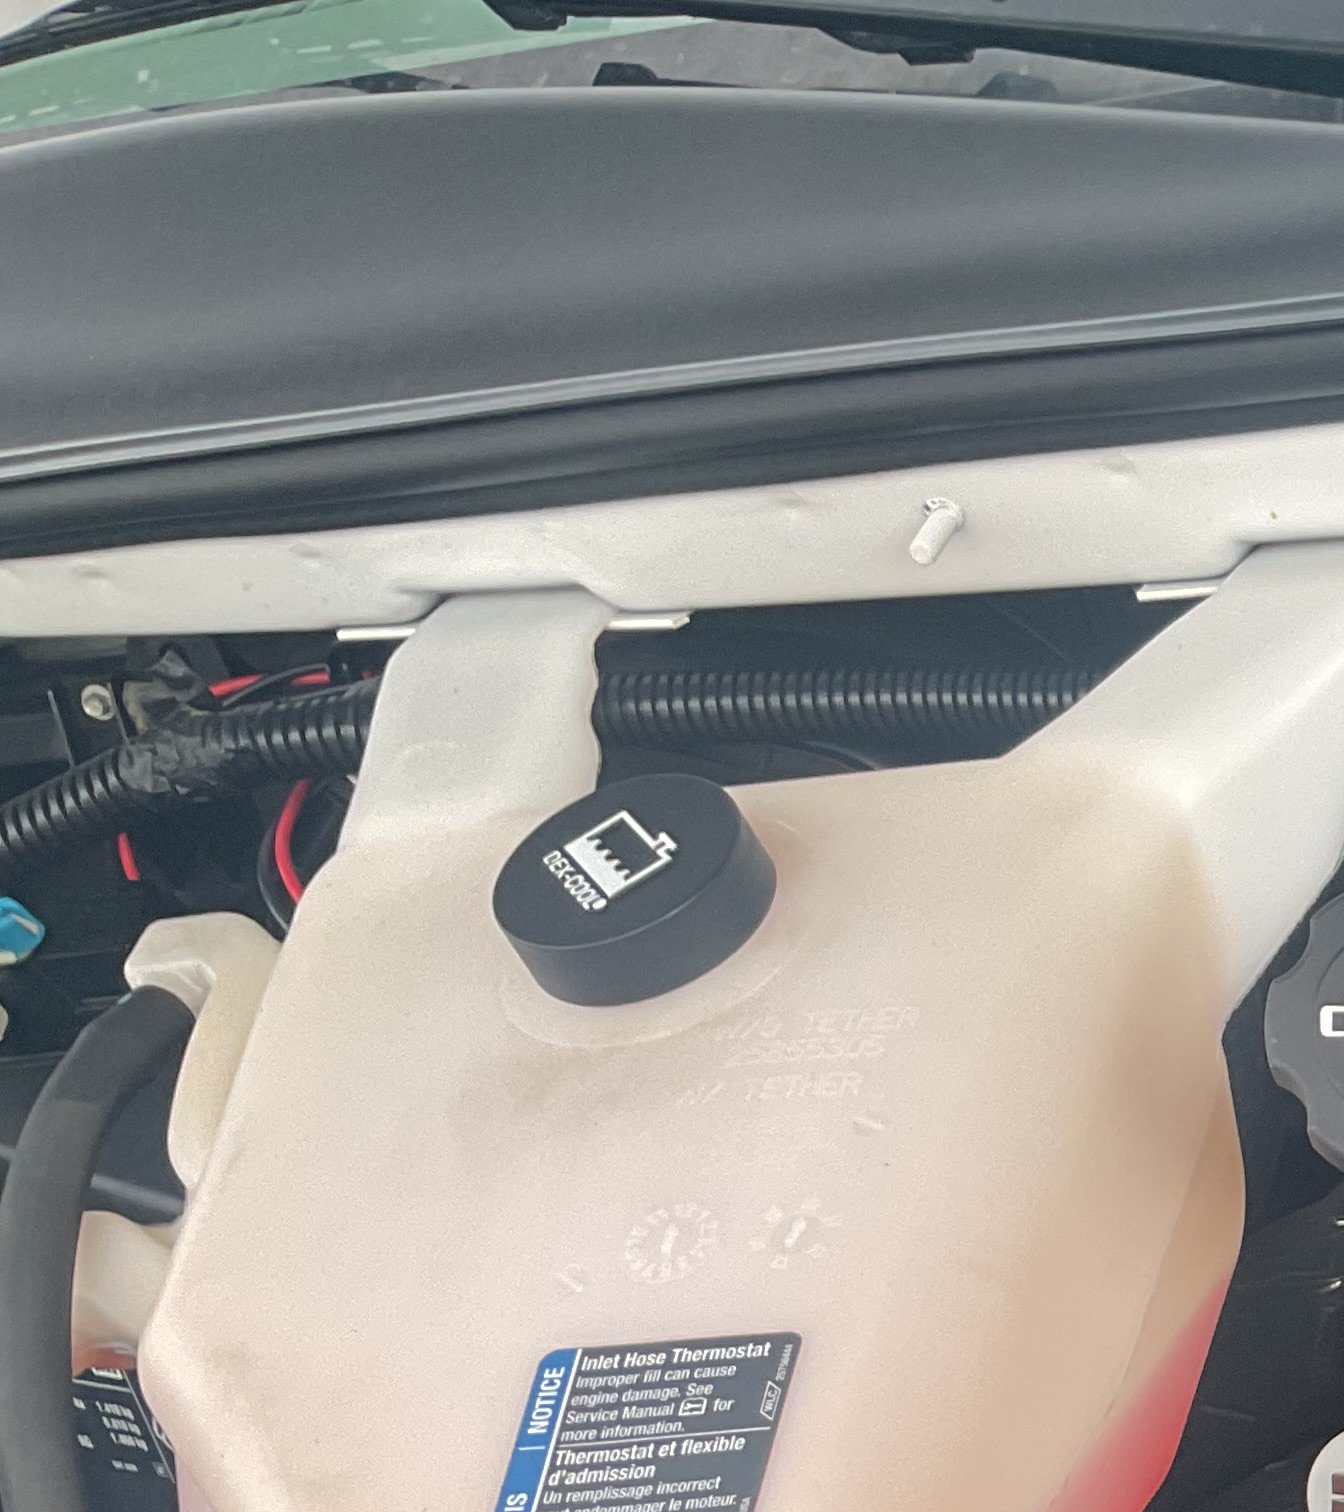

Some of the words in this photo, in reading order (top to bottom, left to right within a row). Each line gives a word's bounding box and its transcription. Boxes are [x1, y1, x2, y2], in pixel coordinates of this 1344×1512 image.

[582, 1353, 621, 1371] Inlet
[624, 1351, 666, 1368] Hose
[672, 1342, 771, 1364] Thermostat
[576, 1372, 640, 1391] Improper
[643, 1369, 661, 1383] fill
[664, 1368, 690, 1381] can
[693, 1364, 736, 1379] cause
[528, 1366, 565, 1434] NOTICE
[570, 1390, 619, 1407] engine
[621, 1386, 681, 1403] damage.
[686, 1382, 713, 1397] See
[565, 1408, 618, 1424] Service
[622, 1403, 674, 1419] Manual
[712, 1398, 734, 1412] for
[560, 1426, 597, 1442] more
[601, 1420, 685, 1438] information.
[556, 1446, 653, 1466] Thermostat
[658, 1441, 677, 1457] et
[681, 1436, 745, 1454] flexible
[548, 1464, 656, 1486] d'admission
[543, 1490, 562, 1505] Un
[565, 1484, 652, 1505] remplissage
[656, 1476, 721, 1494] incorrect
[669, 1498, 683, 1511] le
[684, 1494, 736, 1510] moteur.
